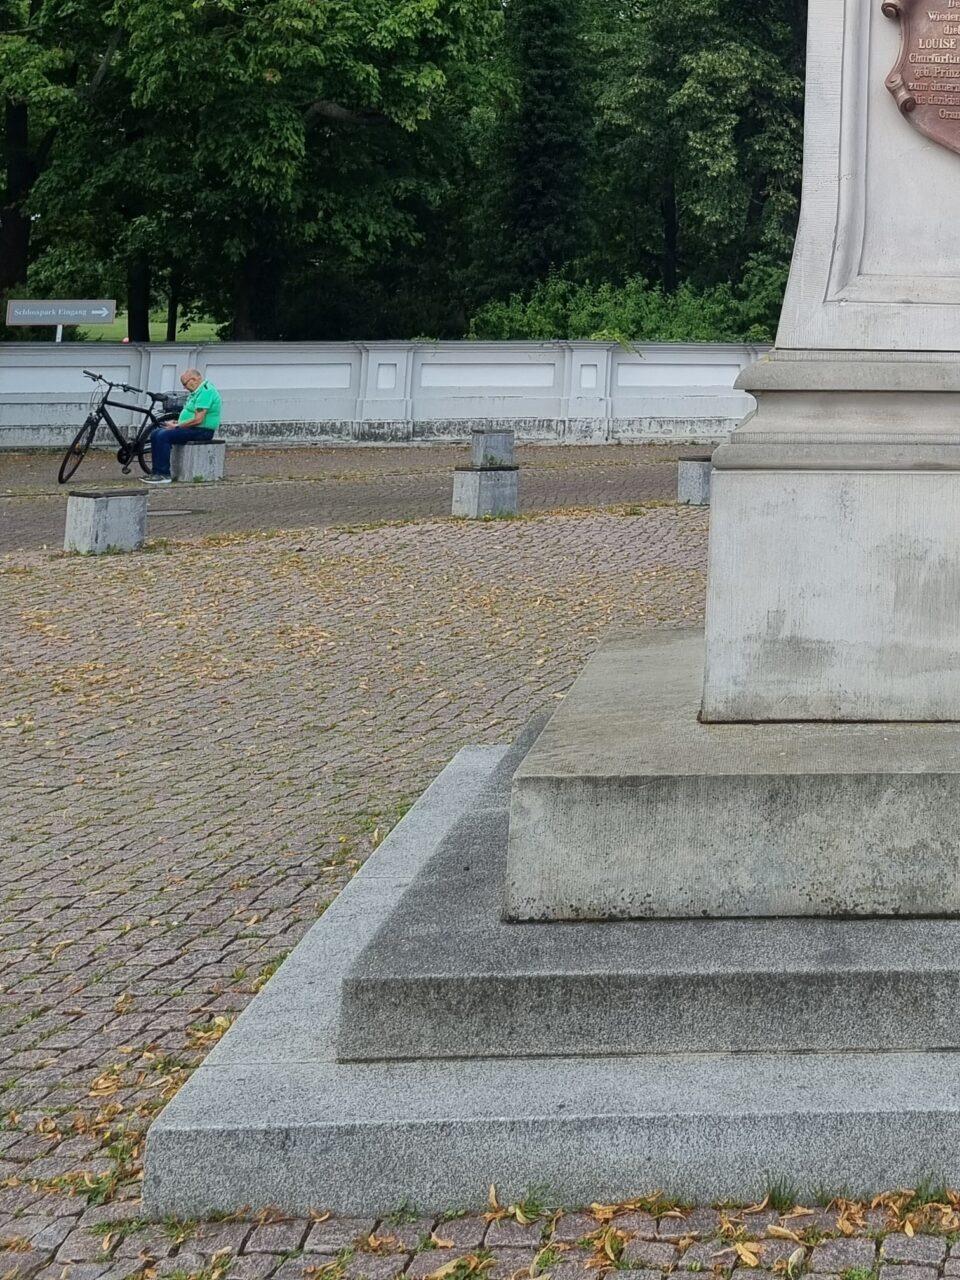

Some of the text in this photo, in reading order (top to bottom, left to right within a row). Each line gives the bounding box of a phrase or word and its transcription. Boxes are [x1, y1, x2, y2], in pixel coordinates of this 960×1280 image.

[918, 38, 957, 49] LOUISE
[908, 82, 928, 91] zum
[58, 308, 87, 316] Eingang
